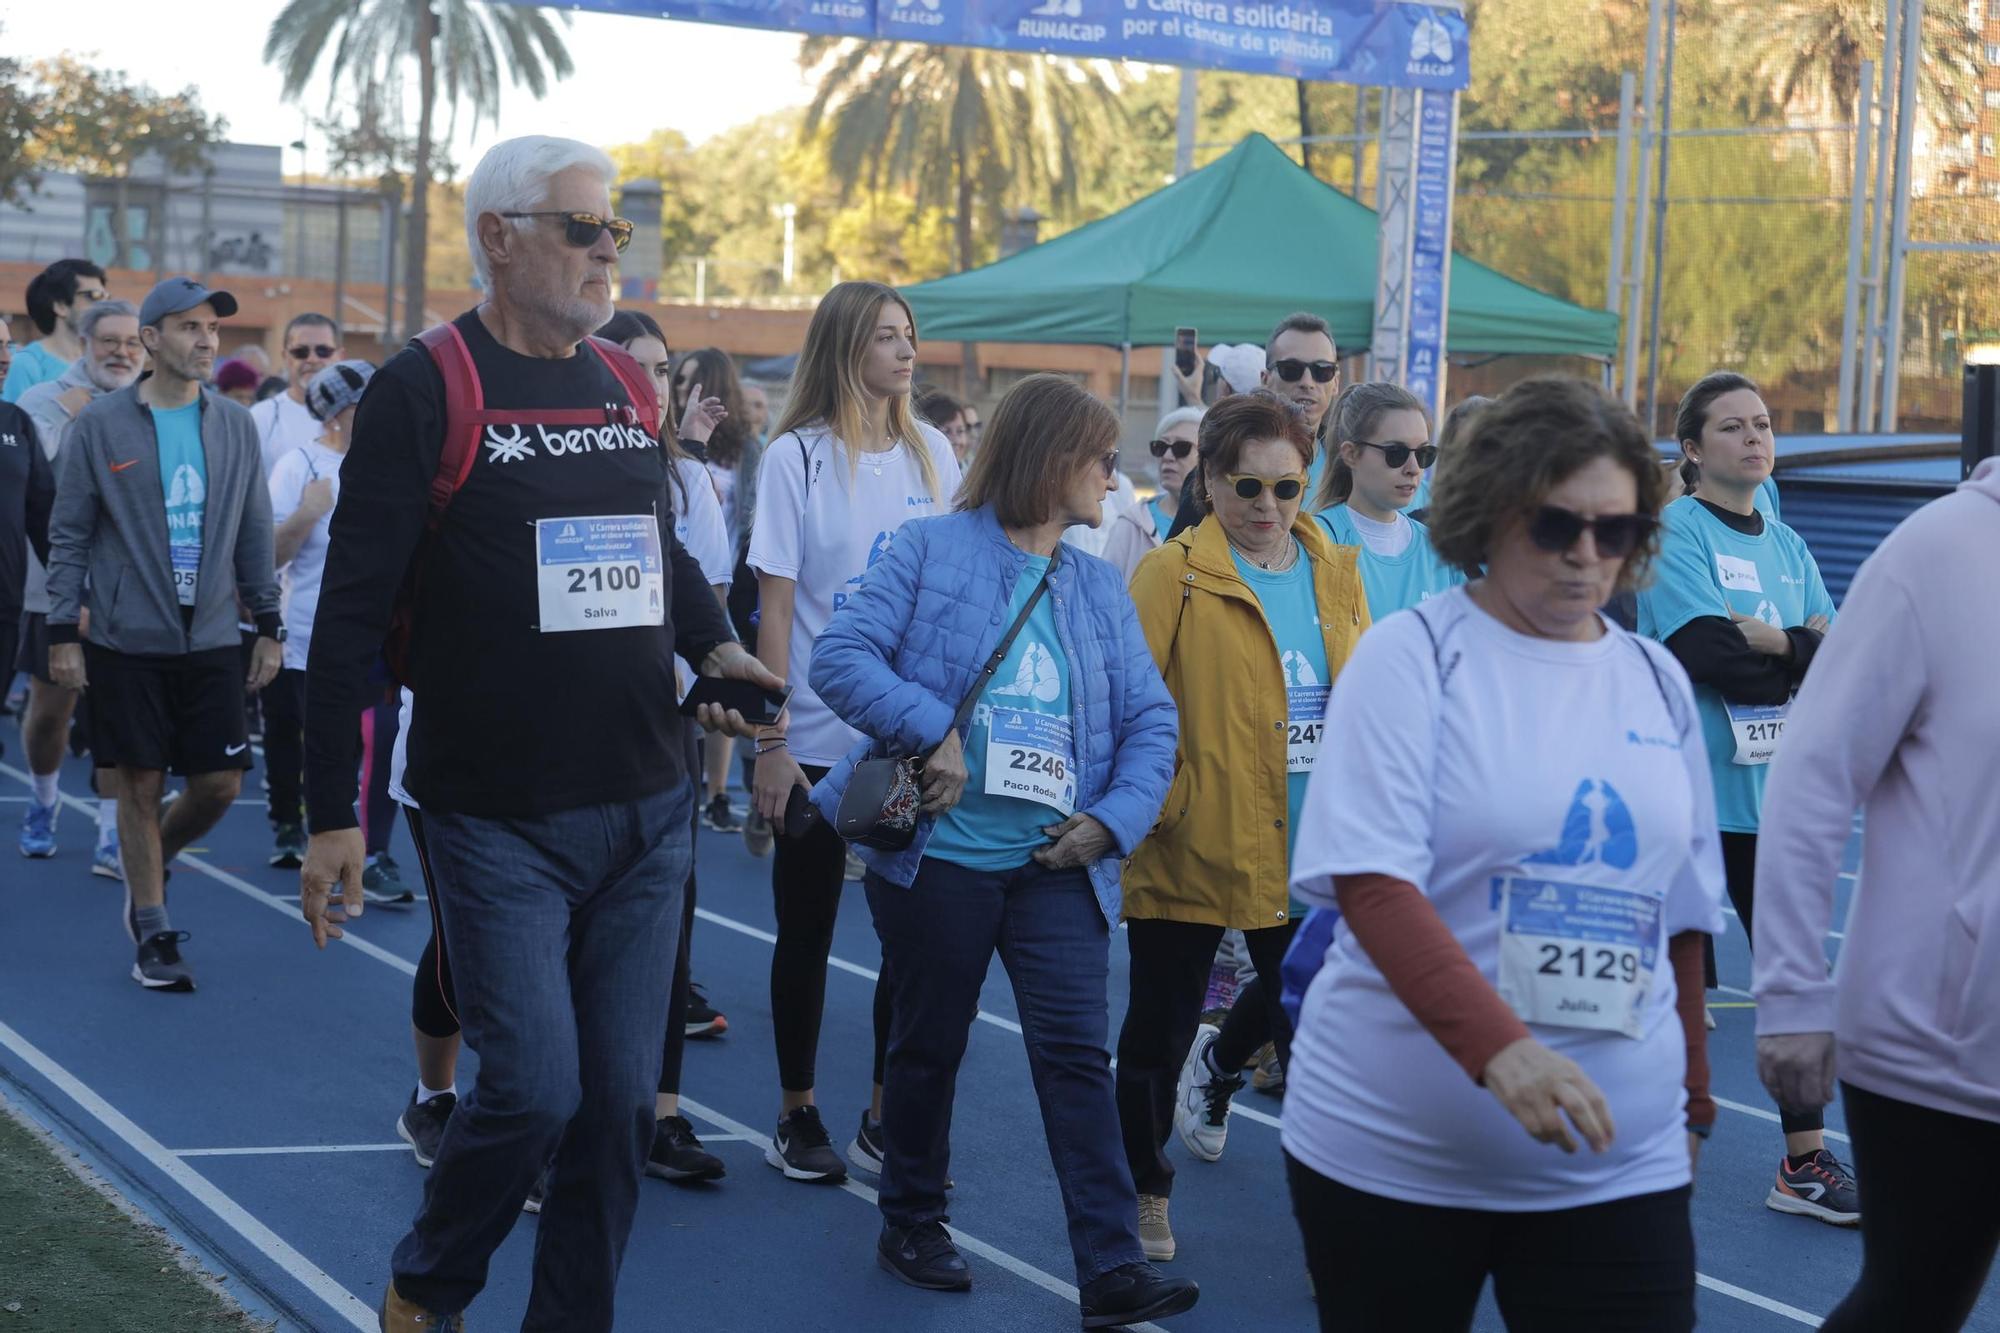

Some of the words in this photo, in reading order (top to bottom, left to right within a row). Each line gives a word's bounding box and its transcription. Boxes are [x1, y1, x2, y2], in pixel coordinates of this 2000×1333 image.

[1146, 0, 1229, 24] Carrera
[1233, 5, 1333, 37] solidaria
[1122, 18, 1158, 40] por
[1161, 17, 1180, 36] el
[1239, 31, 1264, 51] de
[1268, 36, 1334, 62] pulmón
[173, 571, 197, 586] 05
[566, 565, 641, 594] 2100
[584, 607, 617, 619] Salva
[1009, 749, 1065, 781] 2246
[1003, 780, 1030, 792] Paco
[1032, 784, 1057, 800] Rodas
[1537, 944, 1638, 984] 2129
[1556, 997, 1599, 1013] Julia
